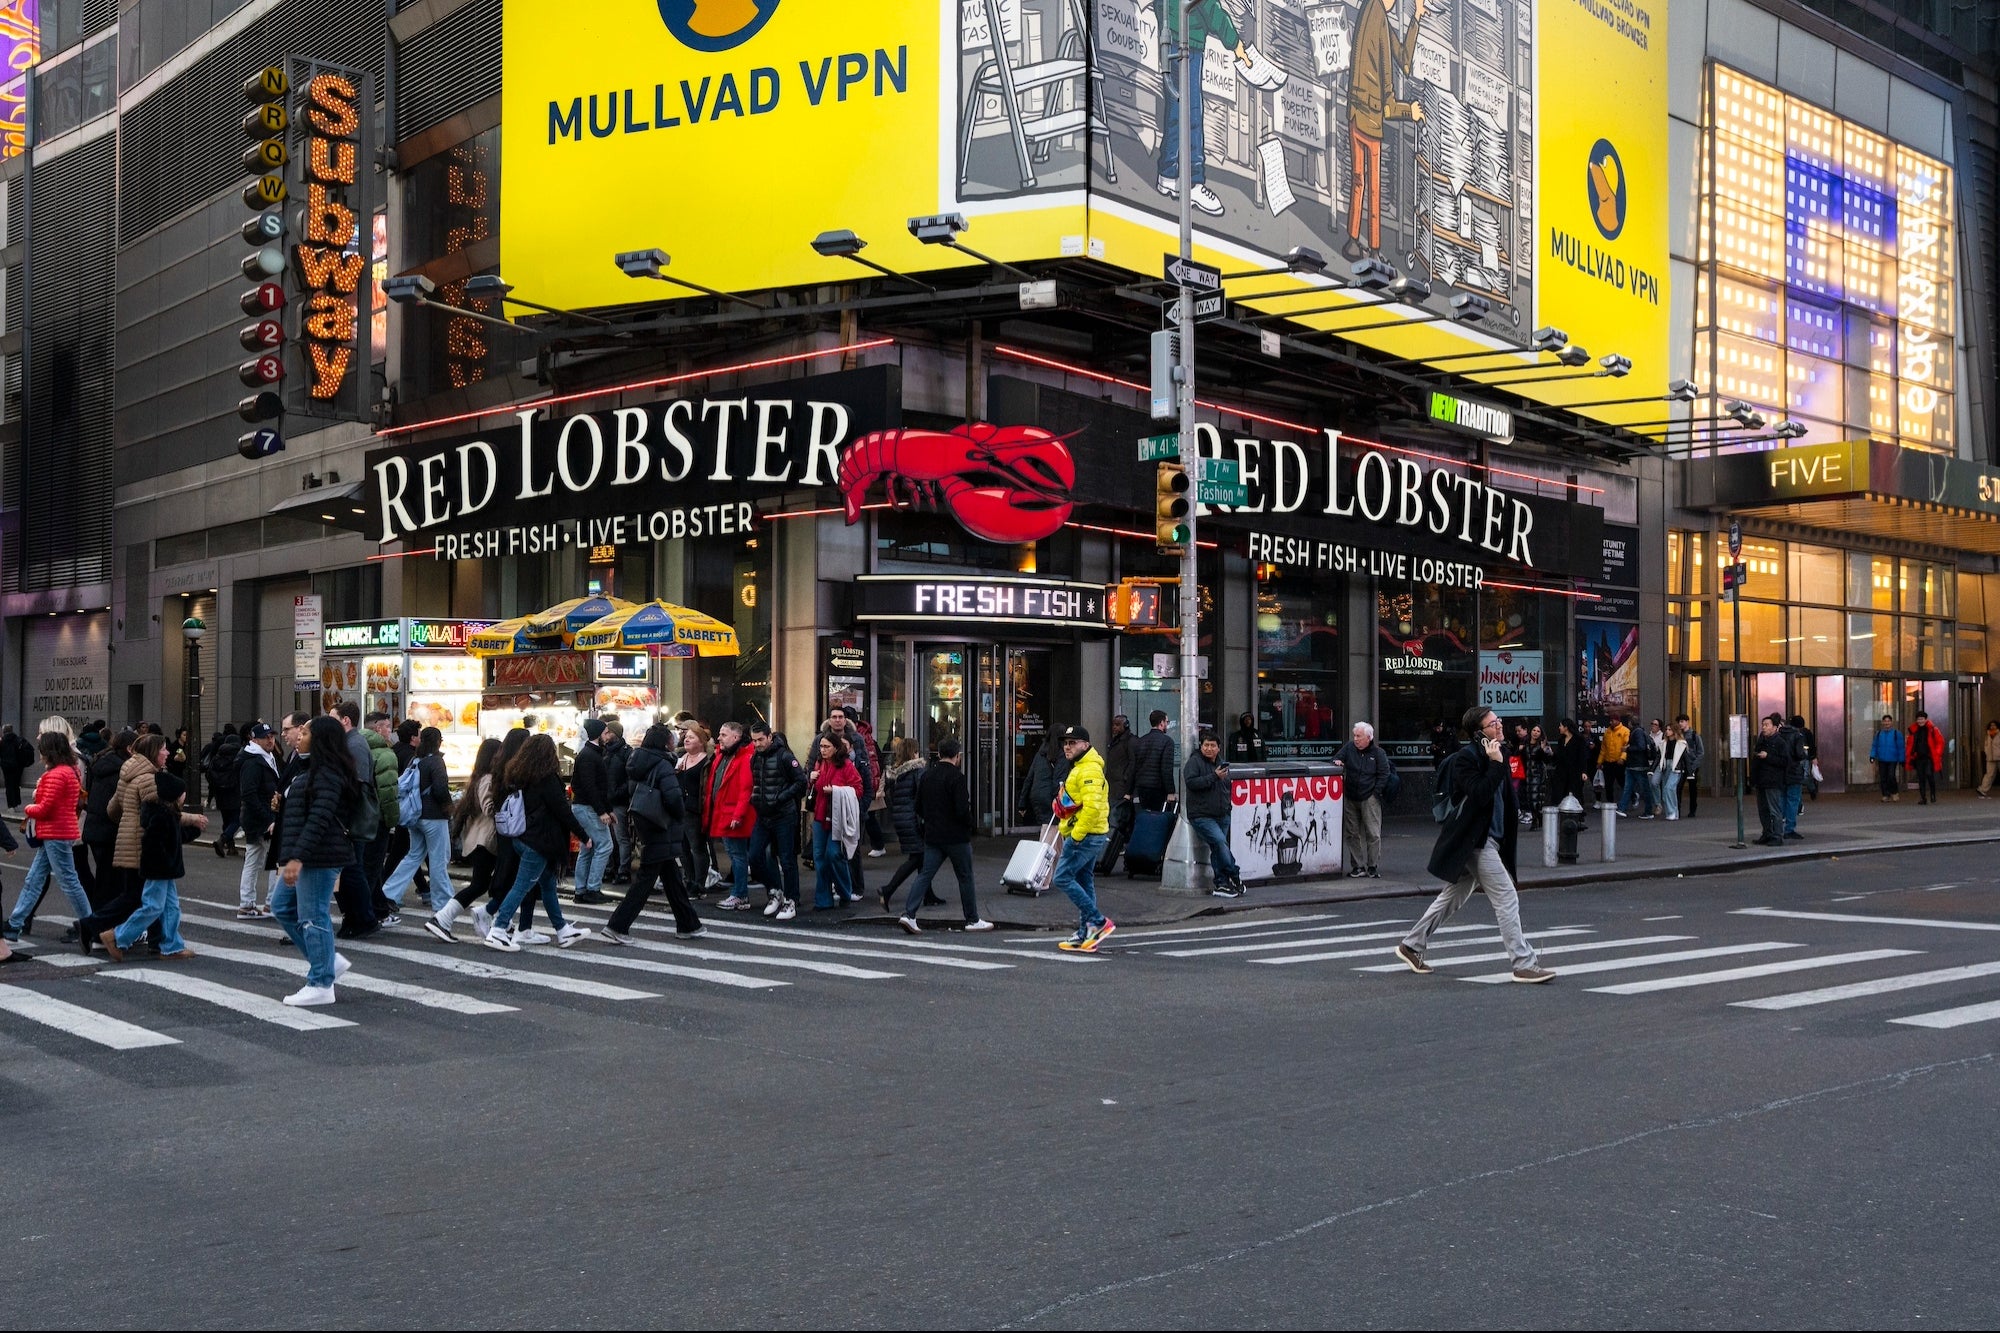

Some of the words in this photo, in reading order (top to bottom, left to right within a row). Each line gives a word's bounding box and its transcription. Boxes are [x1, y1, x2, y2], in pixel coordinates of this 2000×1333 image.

[961, 0, 1011, 21] MUSC
[961, 19, 1012, 42] TASE
[1101, 4, 1155, 39] SEXUALITY
[1311, 17, 1345, 32] EVERYTHING
[1107, 27, 1148, 59] (DOUBTS)
[1320, 34, 1340, 50] MUST
[1616, 16, 1648, 51] BROWSER
[1326, 48, 1340, 65] GO!
[1416, 42, 1447, 69] PROSTATE
[267, 73, 282, 91] N
[1202, 69, 1234, 92] LEAKAGE
[1420, 62, 1441, 82] ISSUES
[548, 67, 780, 145] MULLVAD
[799, 45, 907, 106] VPN
[1286, 81, 1313, 103] UNCLE
[266, 106, 280, 126] R
[1281, 96, 1319, 124] ROBERT'S
[1284, 116, 1320, 141] FUNERAL
[266, 143, 282, 163] Q
[262, 178, 282, 198] W
[264, 215, 281, 234] S
[297, 74, 366, 399] Subway
[1175, 265, 1191, 280] ONE
[1199, 271, 1215, 286] WAY
[1551, 226, 1625, 290] MULLVAD
[1629, 265, 1658, 306] VPN
[264, 288, 274, 306] 1
[1197, 299, 1217, 314] WAY
[264, 324, 278, 343] 2
[263, 359, 278, 379] 3
[261, 432, 275, 451] 7
[1149, 440, 1157, 456] W
[1160, 438, 1169, 455] 41
[1172, 437, 1179, 448] St
[372, 440, 498, 545] RED
[514, 395, 850, 501] LOBSTER
[1213, 462, 1219, 479] 7
[1222, 463, 1230, 473] Av
[1771, 453, 1842, 488] FIVE
[1199, 483, 1234, 502] Fashion
[1237, 487, 1245, 497] Av
[1323, 428, 1534, 568] LOBSTER
[435, 529, 500, 561] FRESH
[510, 524, 557, 556] FISH
[576, 515, 626, 549] LIVE
[637, 501, 754, 542] LOBSTER
[1249, 531, 1310, 567] FRESH
[1317, 542, 1358, 573] FISH
[1371, 551, 1406, 580] LIVE
[1413, 558, 1485, 590] LOBSTER
[1603, 549, 1625, 559] IFETIME
[915, 585, 1013, 614] FRESH
[1024, 588, 1081, 618] FISH
[411, 624, 461, 642] HALAL
[679, 628, 732, 643] SABRETT
[56, 657, 69, 667] TIMES
[70, 655, 88, 667] SQUARE
[843, 647, 865, 656] LOBSTER
[1385, 657, 1404, 671] RED
[1405, 655, 1443, 671] LOBSTER
[45, 678, 54, 691] DO
[56, 678, 70, 691] NOT
[72, 677, 93, 690] BLOCK
[1480, 665, 1540, 689] bsterfest
[33, 696, 60, 712] ACTIVE
[62, 694, 105, 712] DRIVEWAY
[984, 695, 991, 707] A
[1484, 691, 1492, 704] IS
[1496, 690, 1528, 704] BACK!
[1300, 746, 1333, 755] SCALLOPS
[1396, 746, 1418, 754] CRAB
[1231, 775, 1343, 806] CHICAGO
